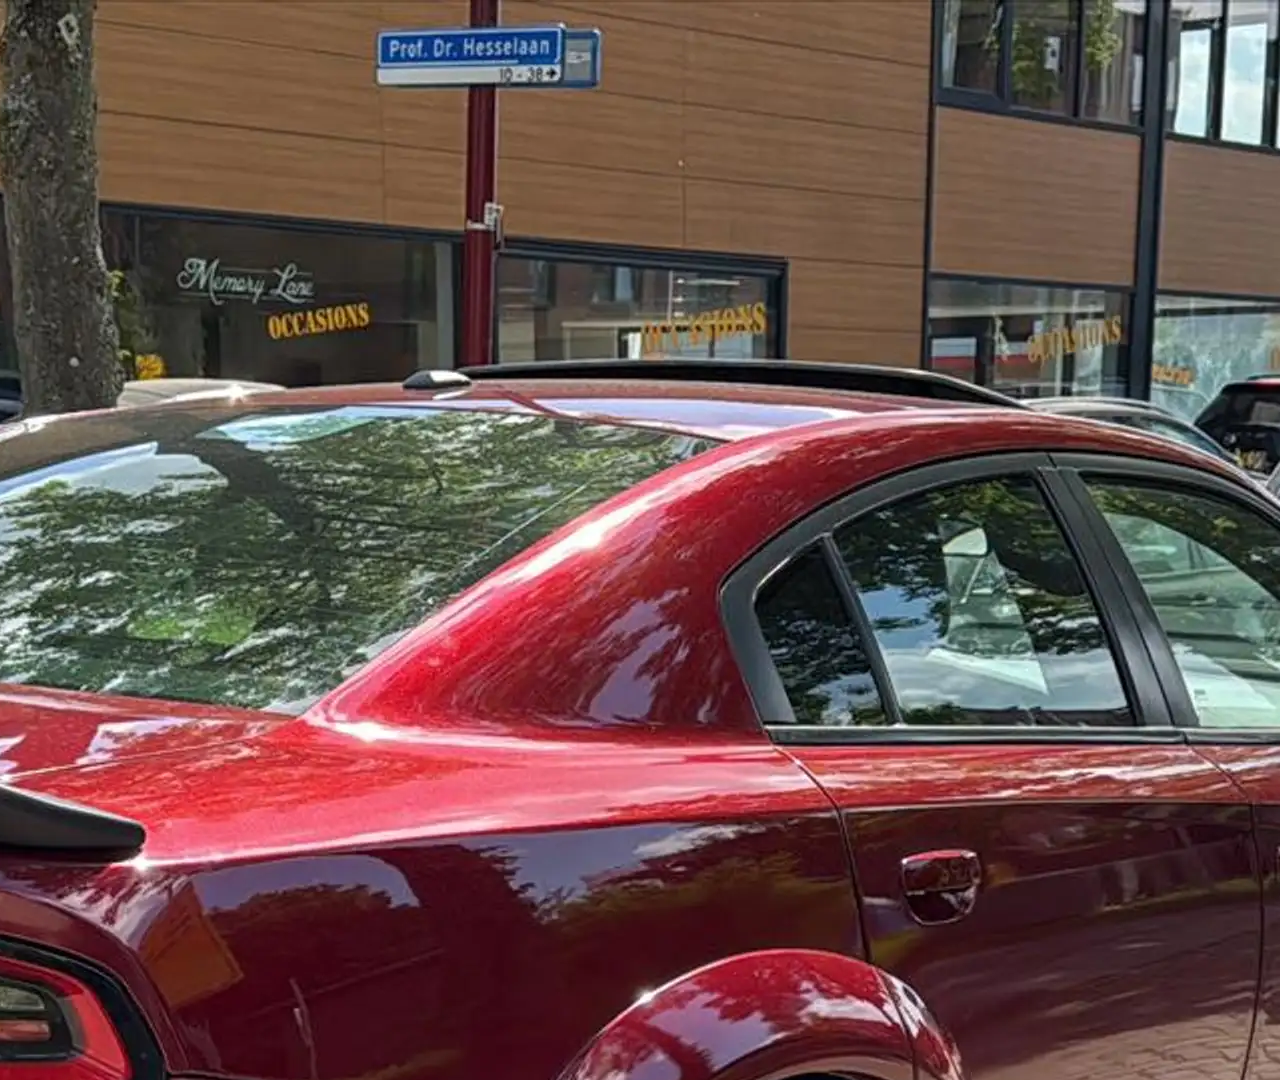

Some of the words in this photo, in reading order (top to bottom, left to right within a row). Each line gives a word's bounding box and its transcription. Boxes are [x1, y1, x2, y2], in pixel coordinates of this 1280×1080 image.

[389, 39, 428, 58] Prof.
[433, 37, 458, 58] Dr.
[463, 36, 550, 56] Hesselaan
[177, 258, 266, 306] Memory
[270, 263, 315, 303] Lane
[268, 302, 370, 339] OCCASIONS
